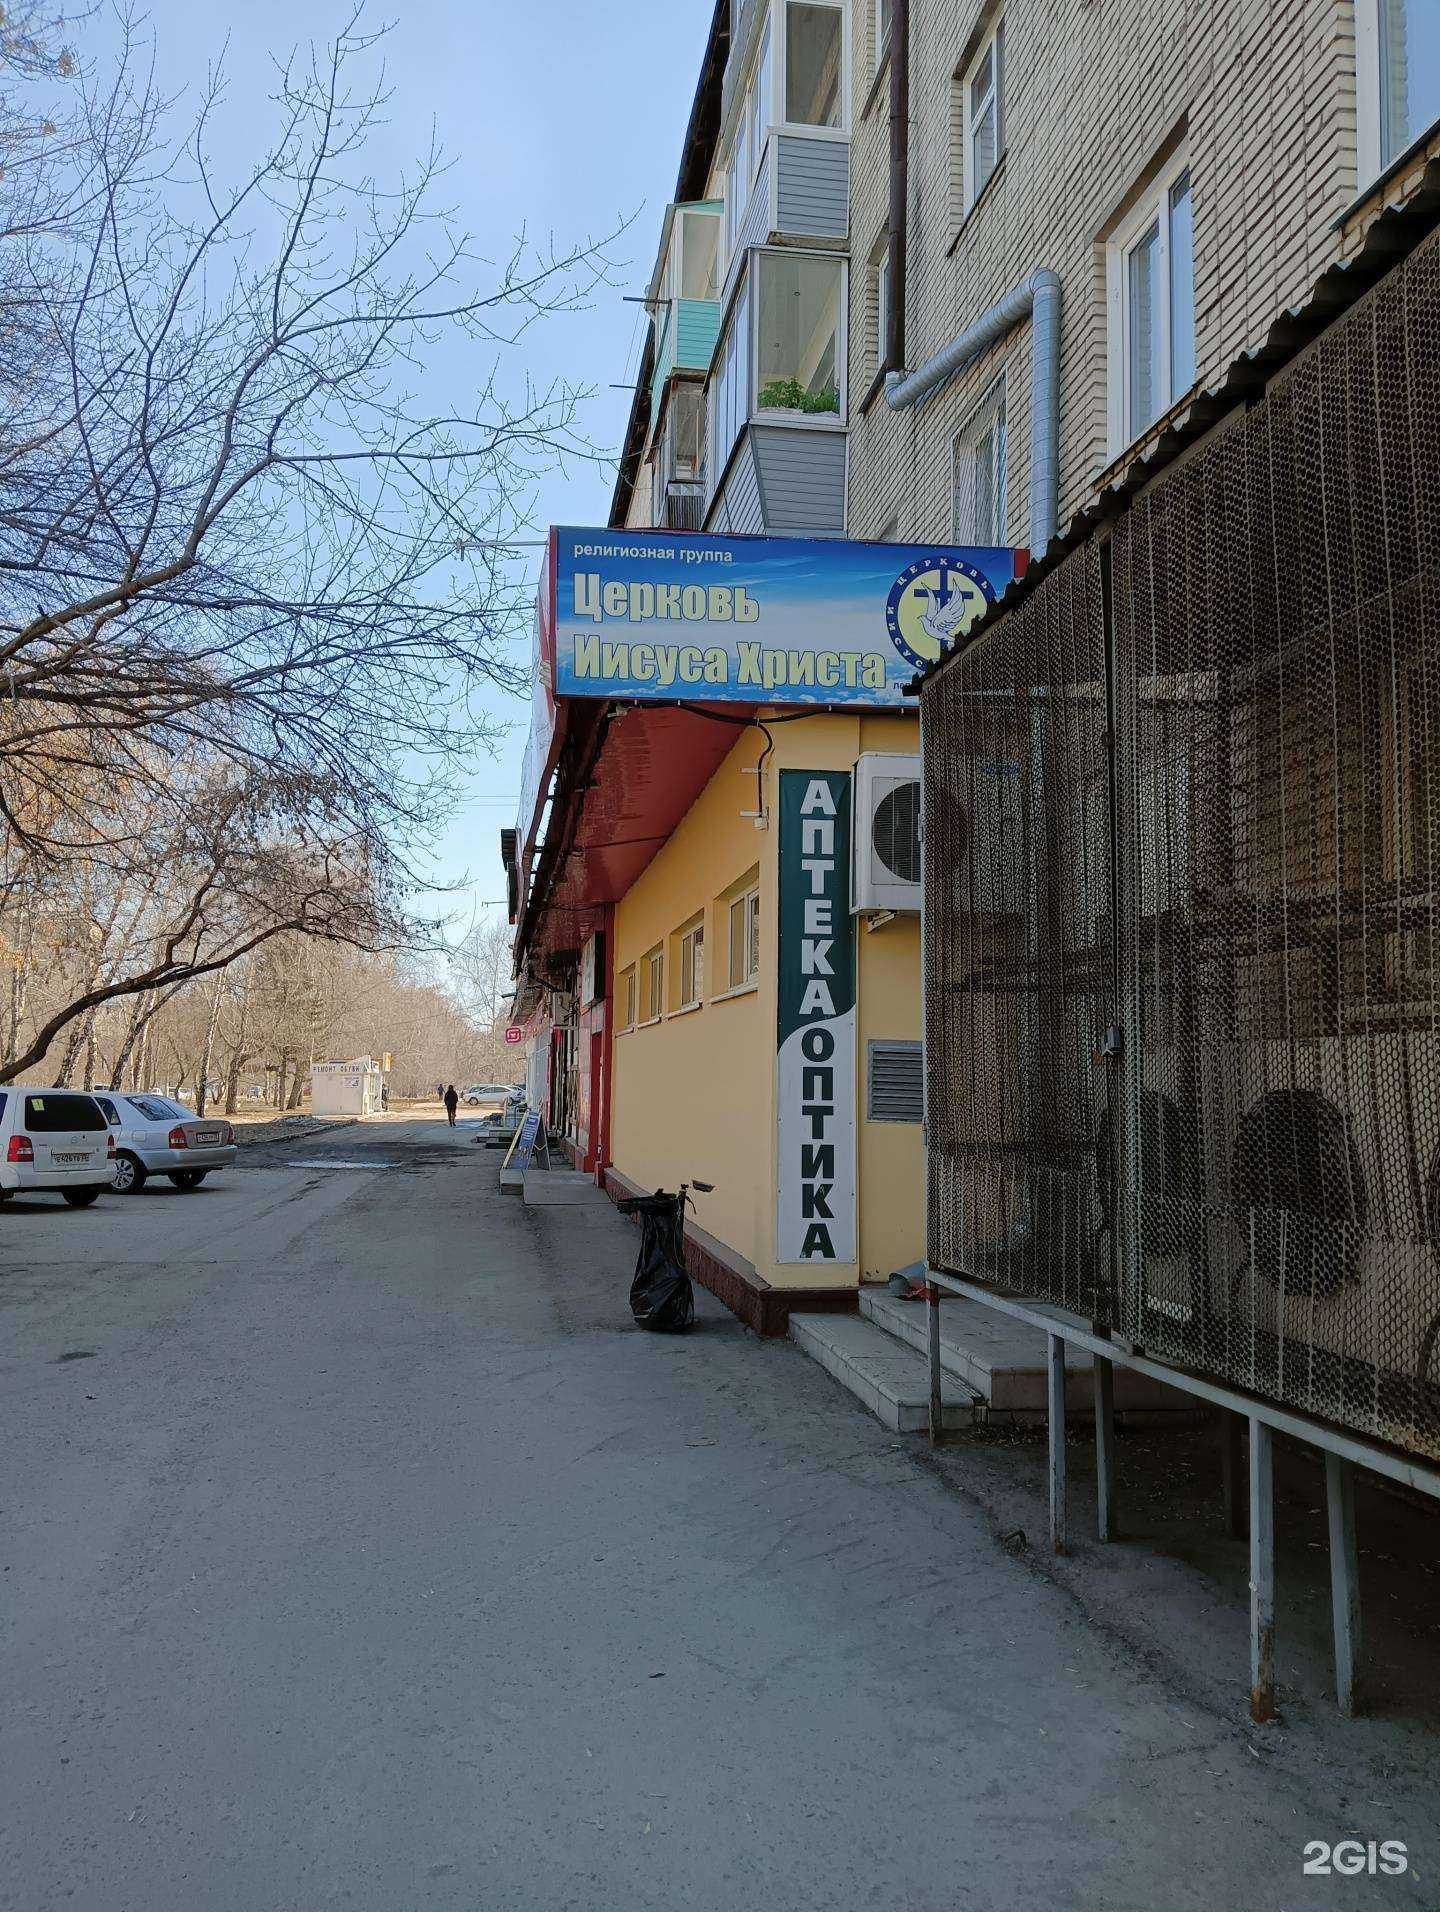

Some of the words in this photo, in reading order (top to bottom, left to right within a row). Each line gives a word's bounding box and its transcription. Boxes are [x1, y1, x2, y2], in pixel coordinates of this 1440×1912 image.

[573, 544, 675, 559] религиозная
[679, 549, 733, 564] группа
[898, 557, 988, 589] ЦЕРКОВЬ
[572, 573, 760, 624] Церковь
[572, 633, 729, 684] Иисуса
[737, 641, 887, 690] Христа
[799, 779, 838, 1015] АПТЕКА
[800, 1027, 837, 1259] ОПТИКА
